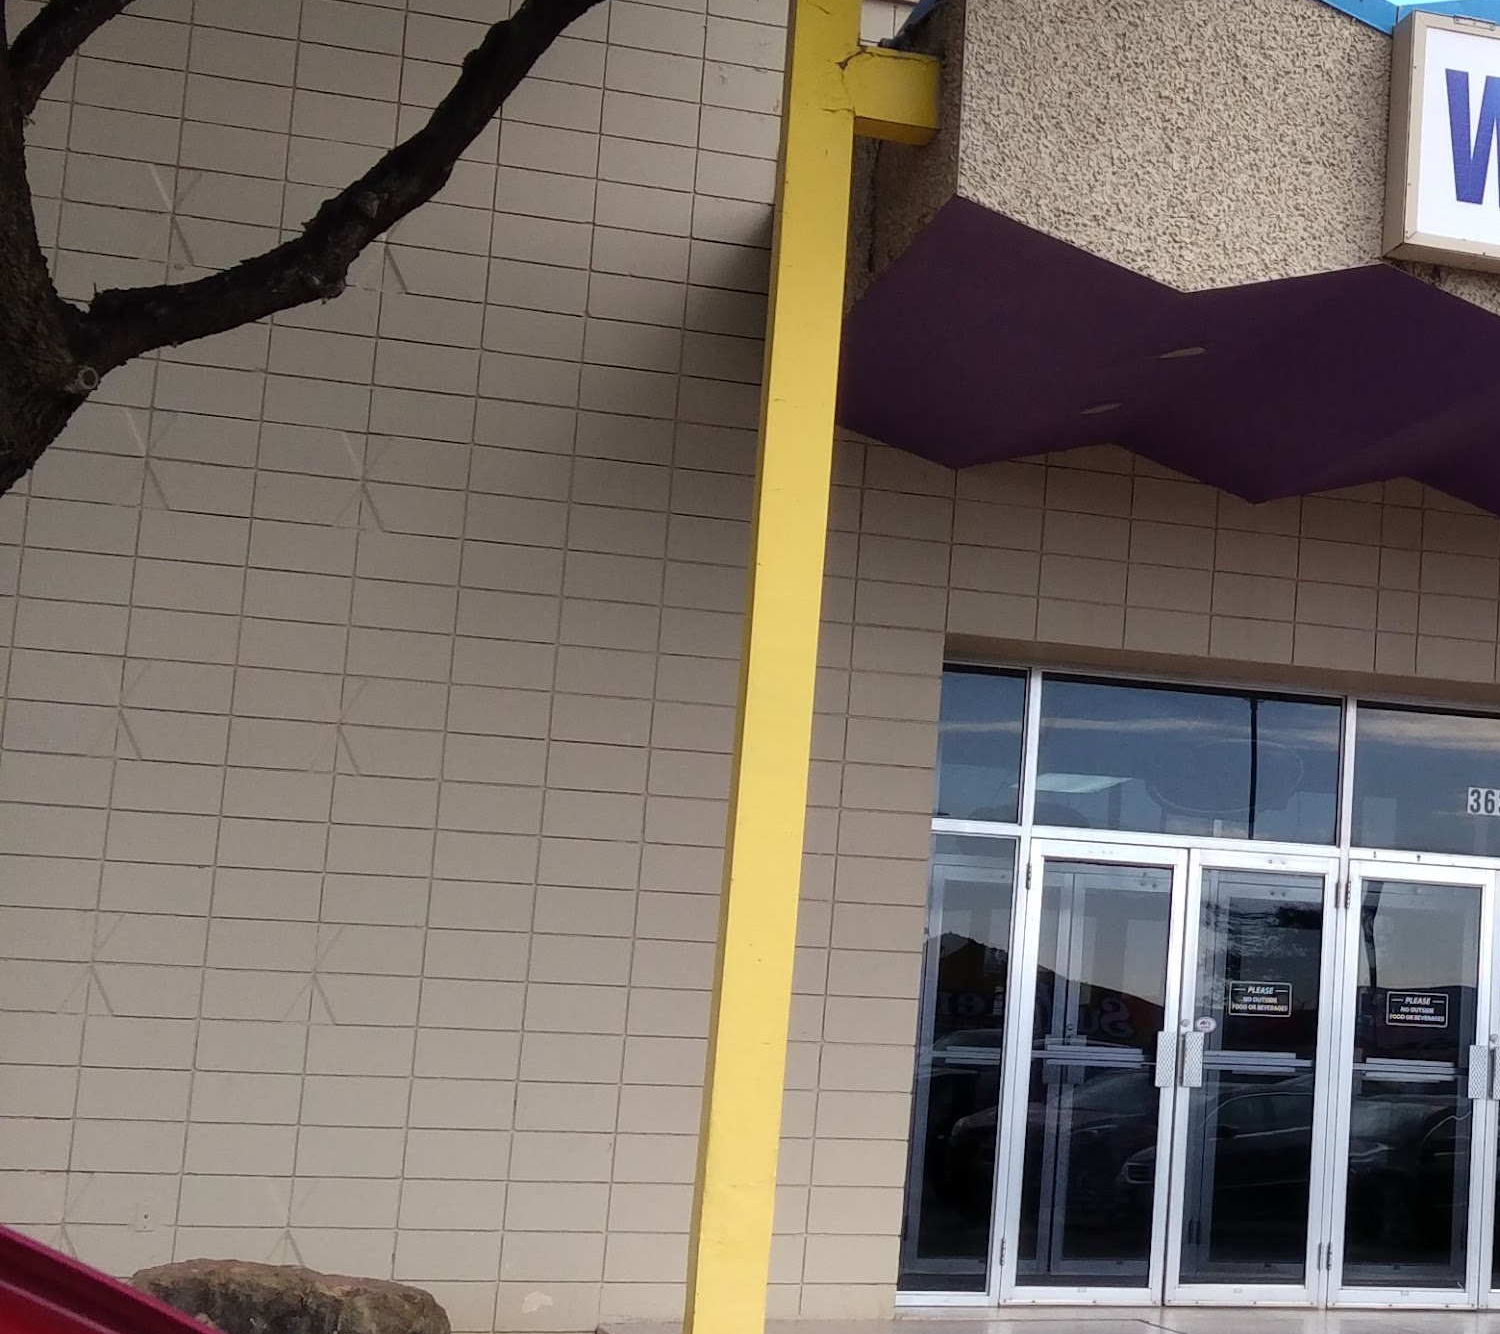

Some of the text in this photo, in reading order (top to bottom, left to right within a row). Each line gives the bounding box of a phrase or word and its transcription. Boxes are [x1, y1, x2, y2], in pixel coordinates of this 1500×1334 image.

[1247, 986, 1274, 995] PLEASE
[1252, 996, 1278, 1004] OUTSIDE
[1404, 996, 1431, 1005] PLEASE
[1231, 1002, 1289, 1012] FOOD OR BEVERAGES
[1414, 1014, 1445, 1022] BEVERAGES
